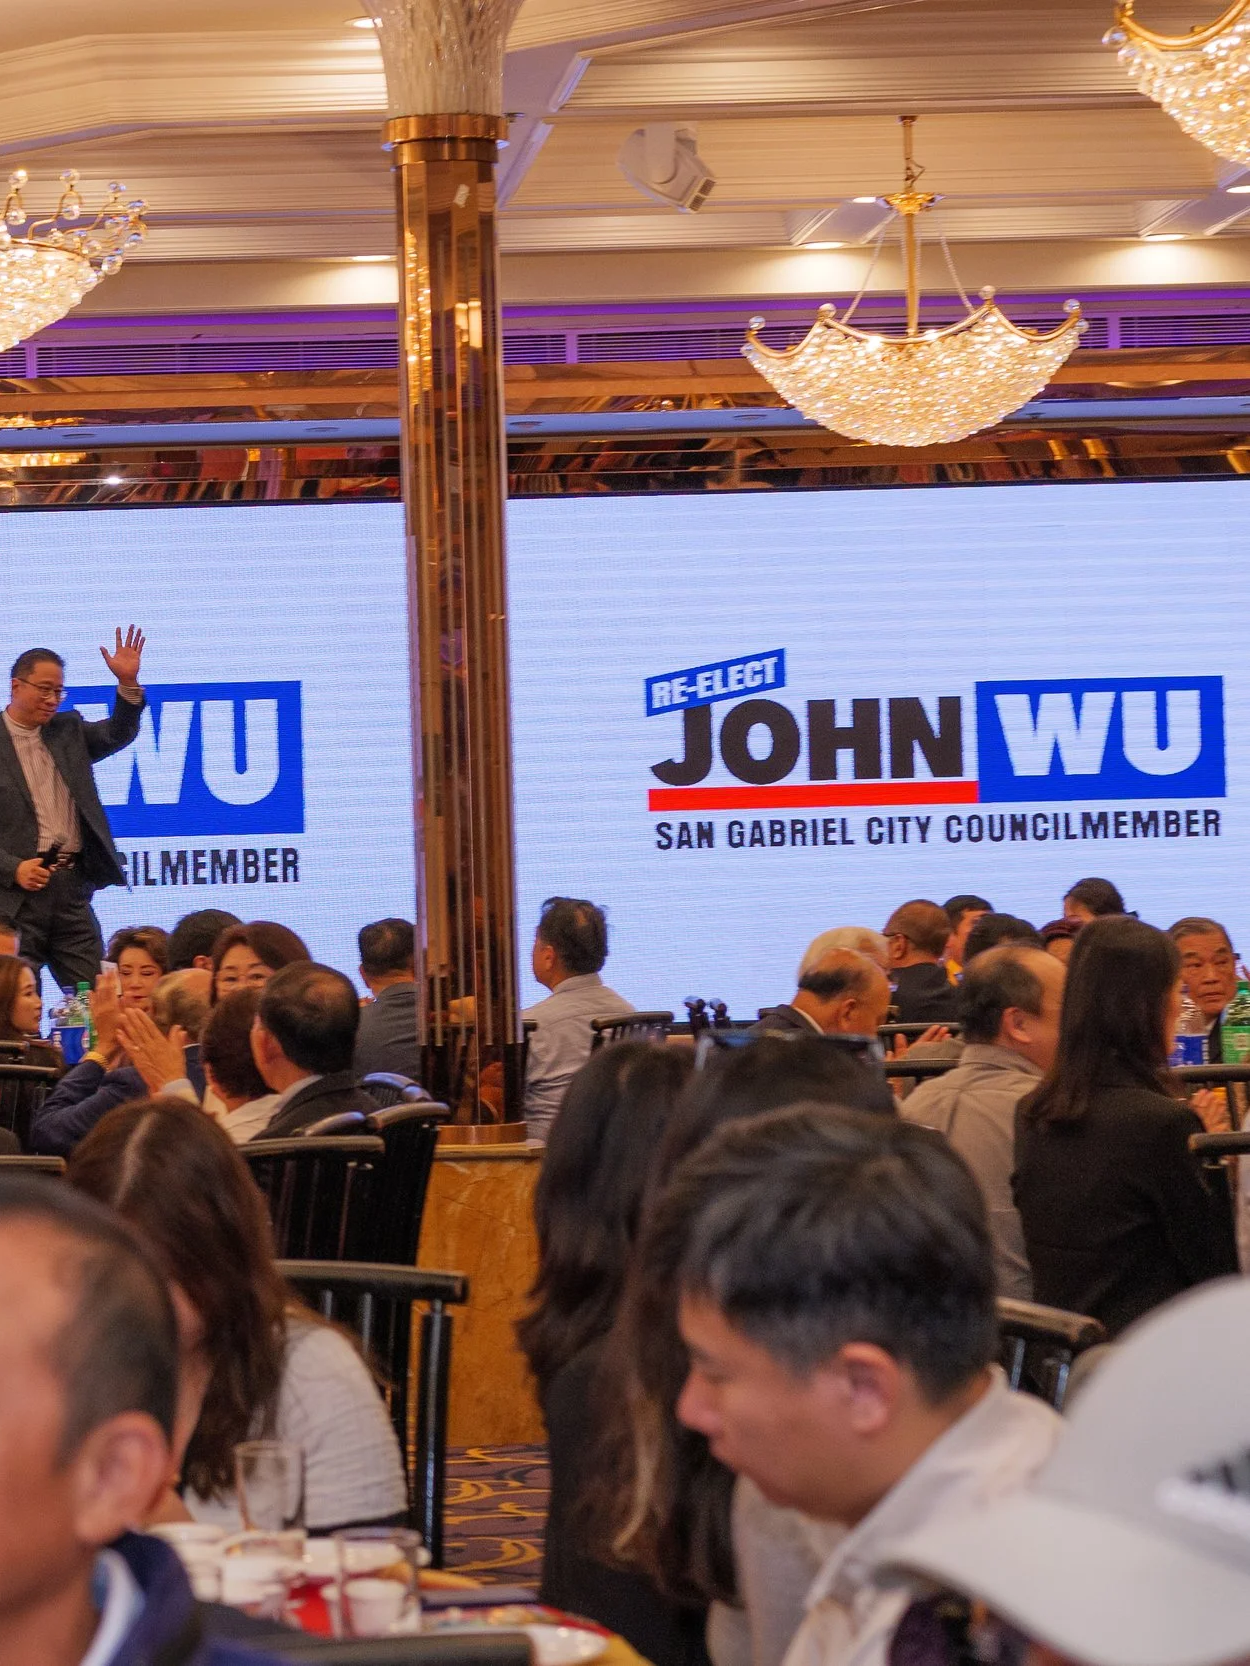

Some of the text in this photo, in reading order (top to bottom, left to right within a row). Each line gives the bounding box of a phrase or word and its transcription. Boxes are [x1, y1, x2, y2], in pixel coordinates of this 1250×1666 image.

[651, 655, 779, 709] RE-ELECT
[650, 690, 1201, 787] JOHN WU
[656, 809, 1221, 851] SAN GABRIEL CITY COUNCILMEMBER
[117, 848, 300, 887] ILMEMBER
